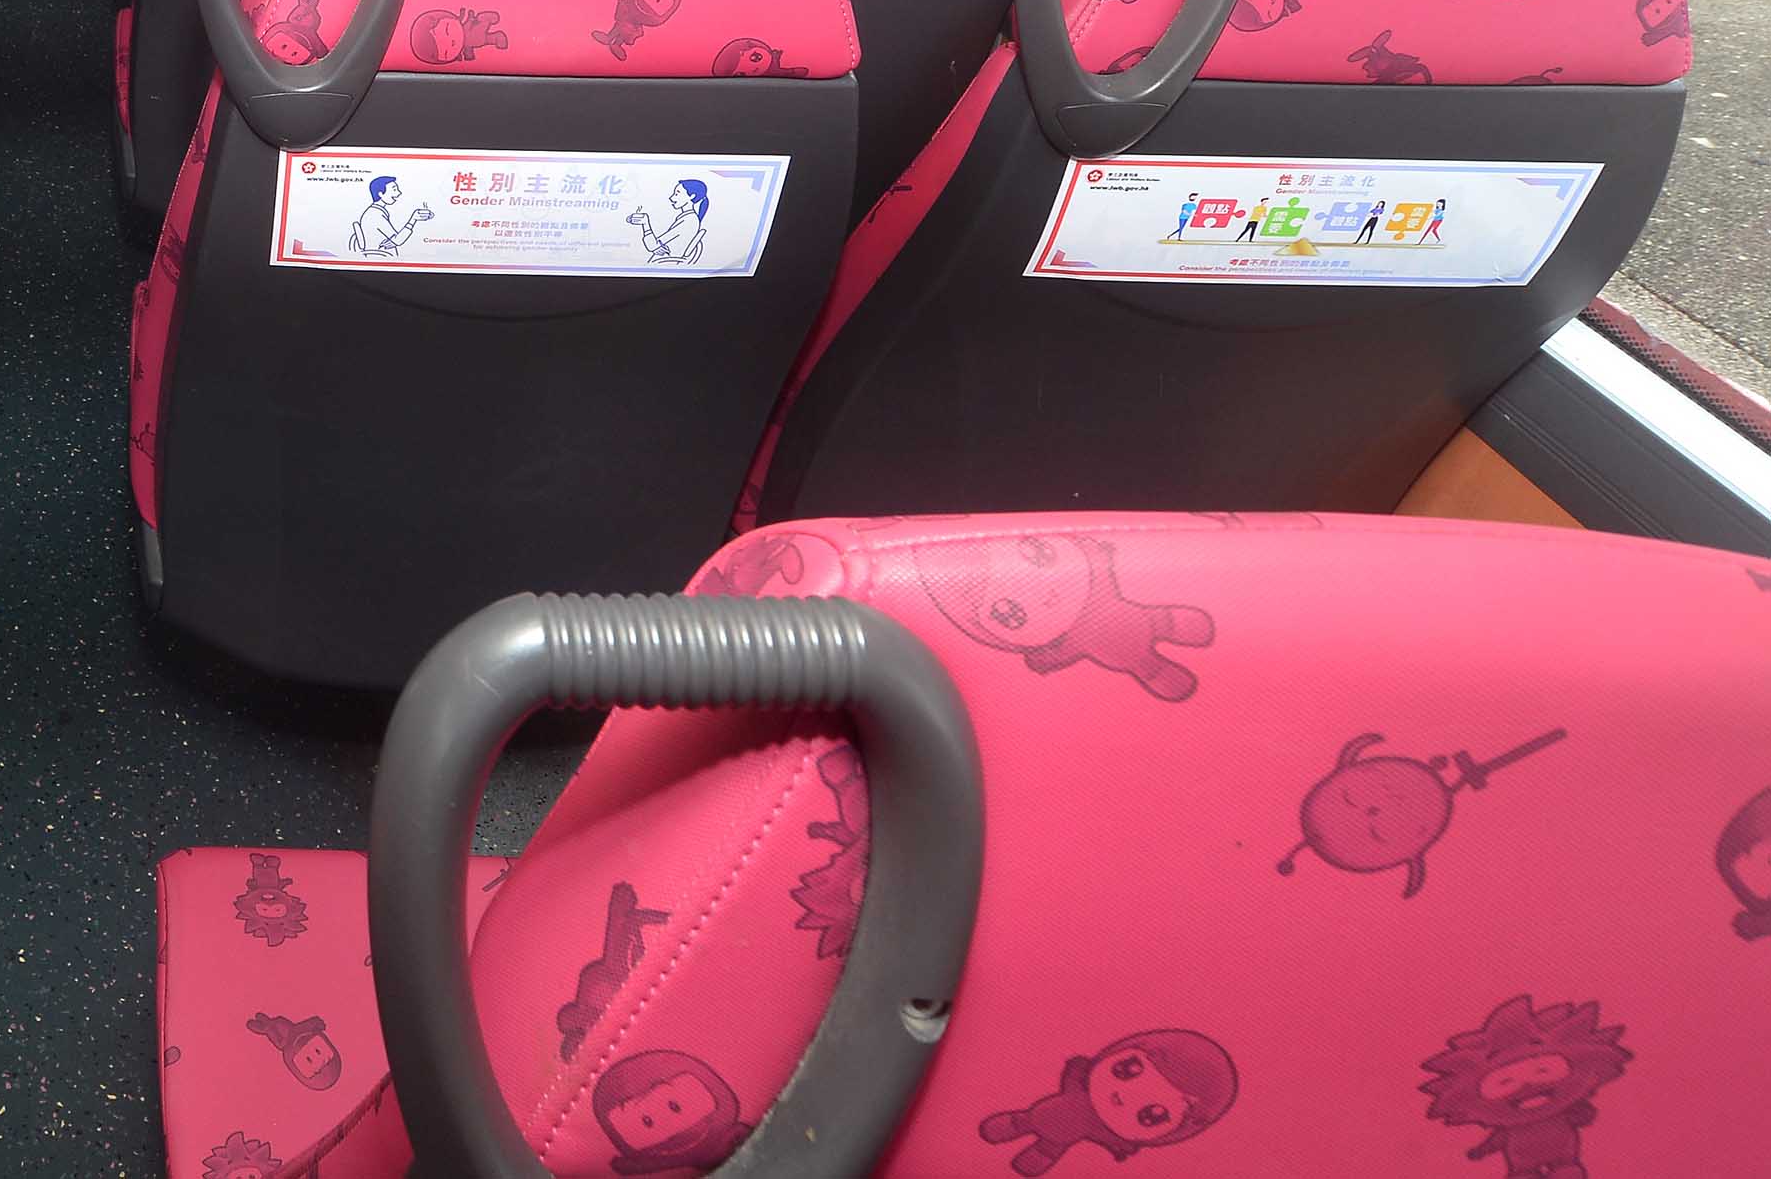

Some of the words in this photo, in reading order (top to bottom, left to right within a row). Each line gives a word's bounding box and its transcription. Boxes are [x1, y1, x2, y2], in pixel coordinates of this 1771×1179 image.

[453, 171, 623, 195] 性別主流化
[1279, 174, 1377, 187] 性別主流化
[450, 195, 505, 206] Gender
[509, 196, 620, 211] Mainstreaming
